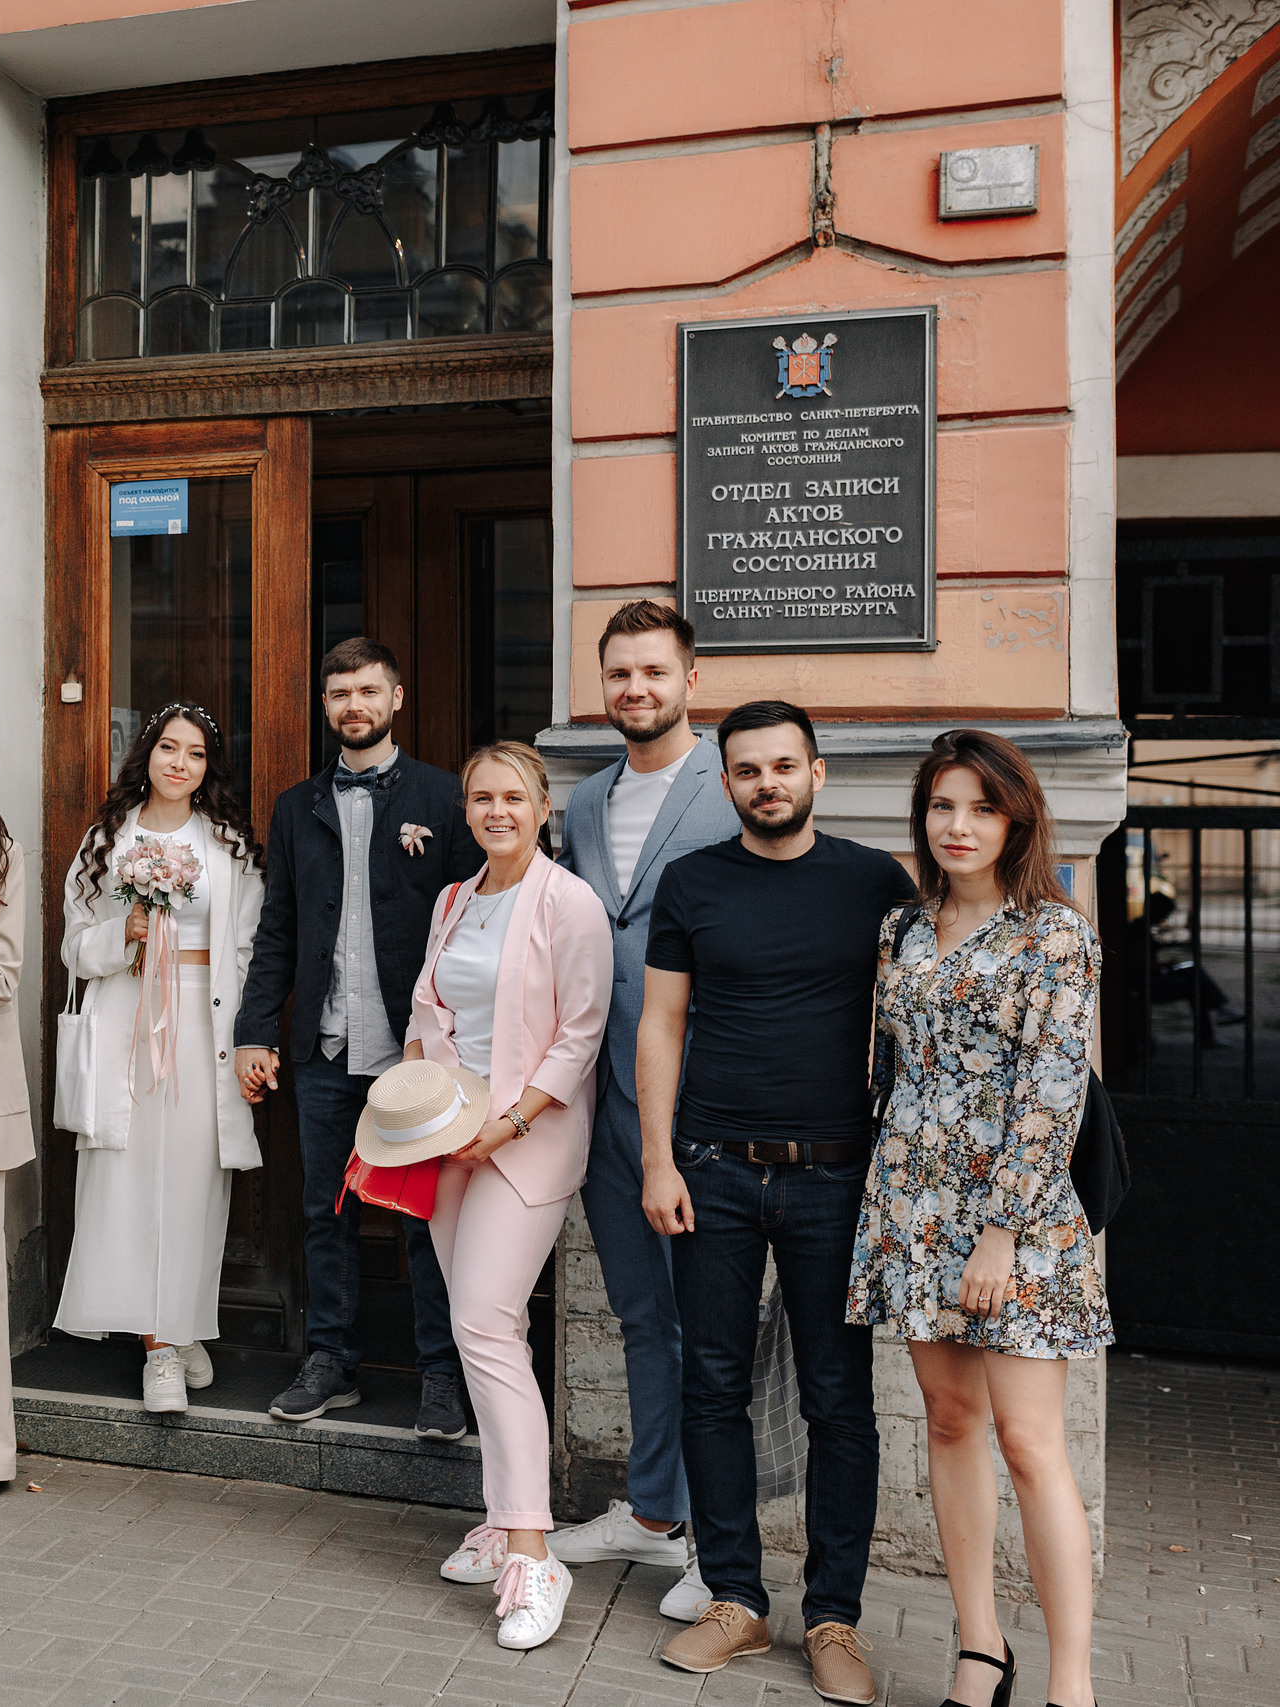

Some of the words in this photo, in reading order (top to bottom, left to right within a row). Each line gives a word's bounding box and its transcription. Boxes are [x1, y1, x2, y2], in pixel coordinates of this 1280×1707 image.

[693, 412, 792, 427] ПРАВИТЕЛЬСТВО
[801, 405, 920, 420] САНКТ-ПЕТЕРБУРГА
[741, 431, 797, 443] КОМИТЕТ
[804, 430, 820, 440] ПО
[825, 427, 869, 439] ДЕЛАМ
[707, 446, 755, 457] ЗАПИСИ
[761, 443, 799, 454] АКТОВ
[805, 438, 904, 452] ГРАЖДАНСКОГО
[767, 454, 842, 466] СОСТОЯНИЯ
[119, 497, 137, 505] ПОД
[139, 493, 179, 503] ОХРАНОЙ
[711, 482, 791, 503] ОТДЕЛ
[805, 477, 900, 498] ЗАПИСИ
[765, 504, 844, 524] АКТОВ
[707, 526, 903, 550] ГРАЖДАНСКОГО
[732, 552, 877, 573] СОСТОЯНИЯ
[695, 586, 836, 604] ЦЕНТРАЛЬНОГО
[845, 582, 916, 600] РАЙОНА
